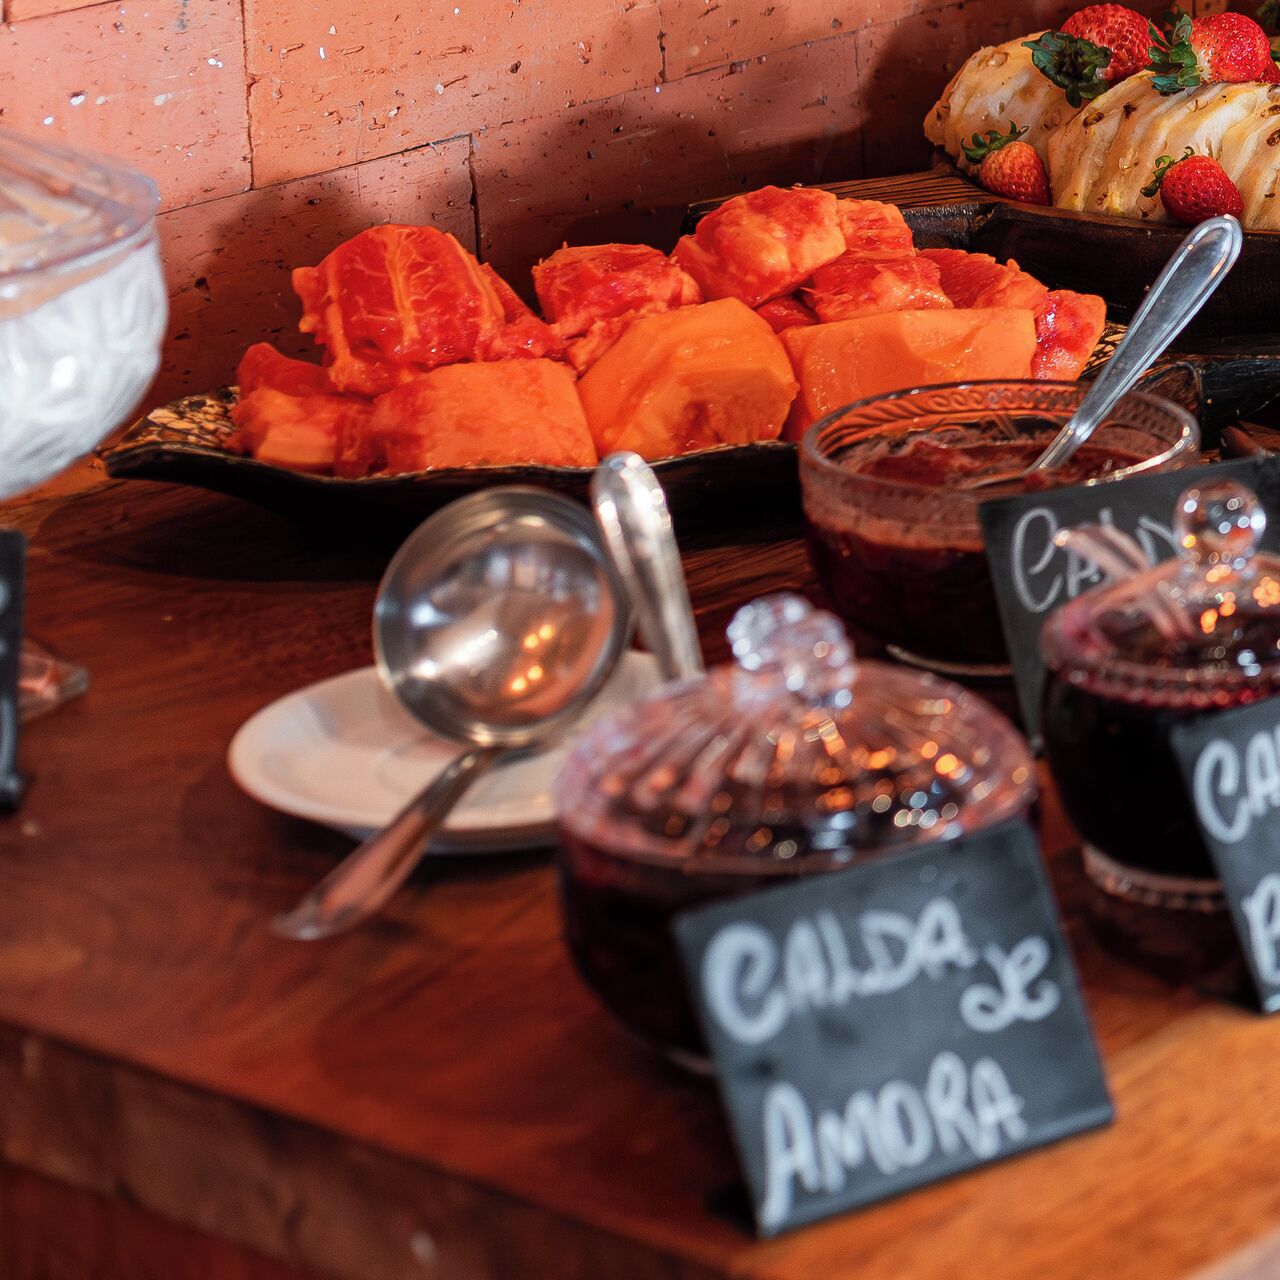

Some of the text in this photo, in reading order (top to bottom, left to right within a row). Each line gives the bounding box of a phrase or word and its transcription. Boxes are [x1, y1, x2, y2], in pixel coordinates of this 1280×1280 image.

[704, 896, 1063, 1046] CALDA de
[758, 1049, 1029, 1230] AMORA
